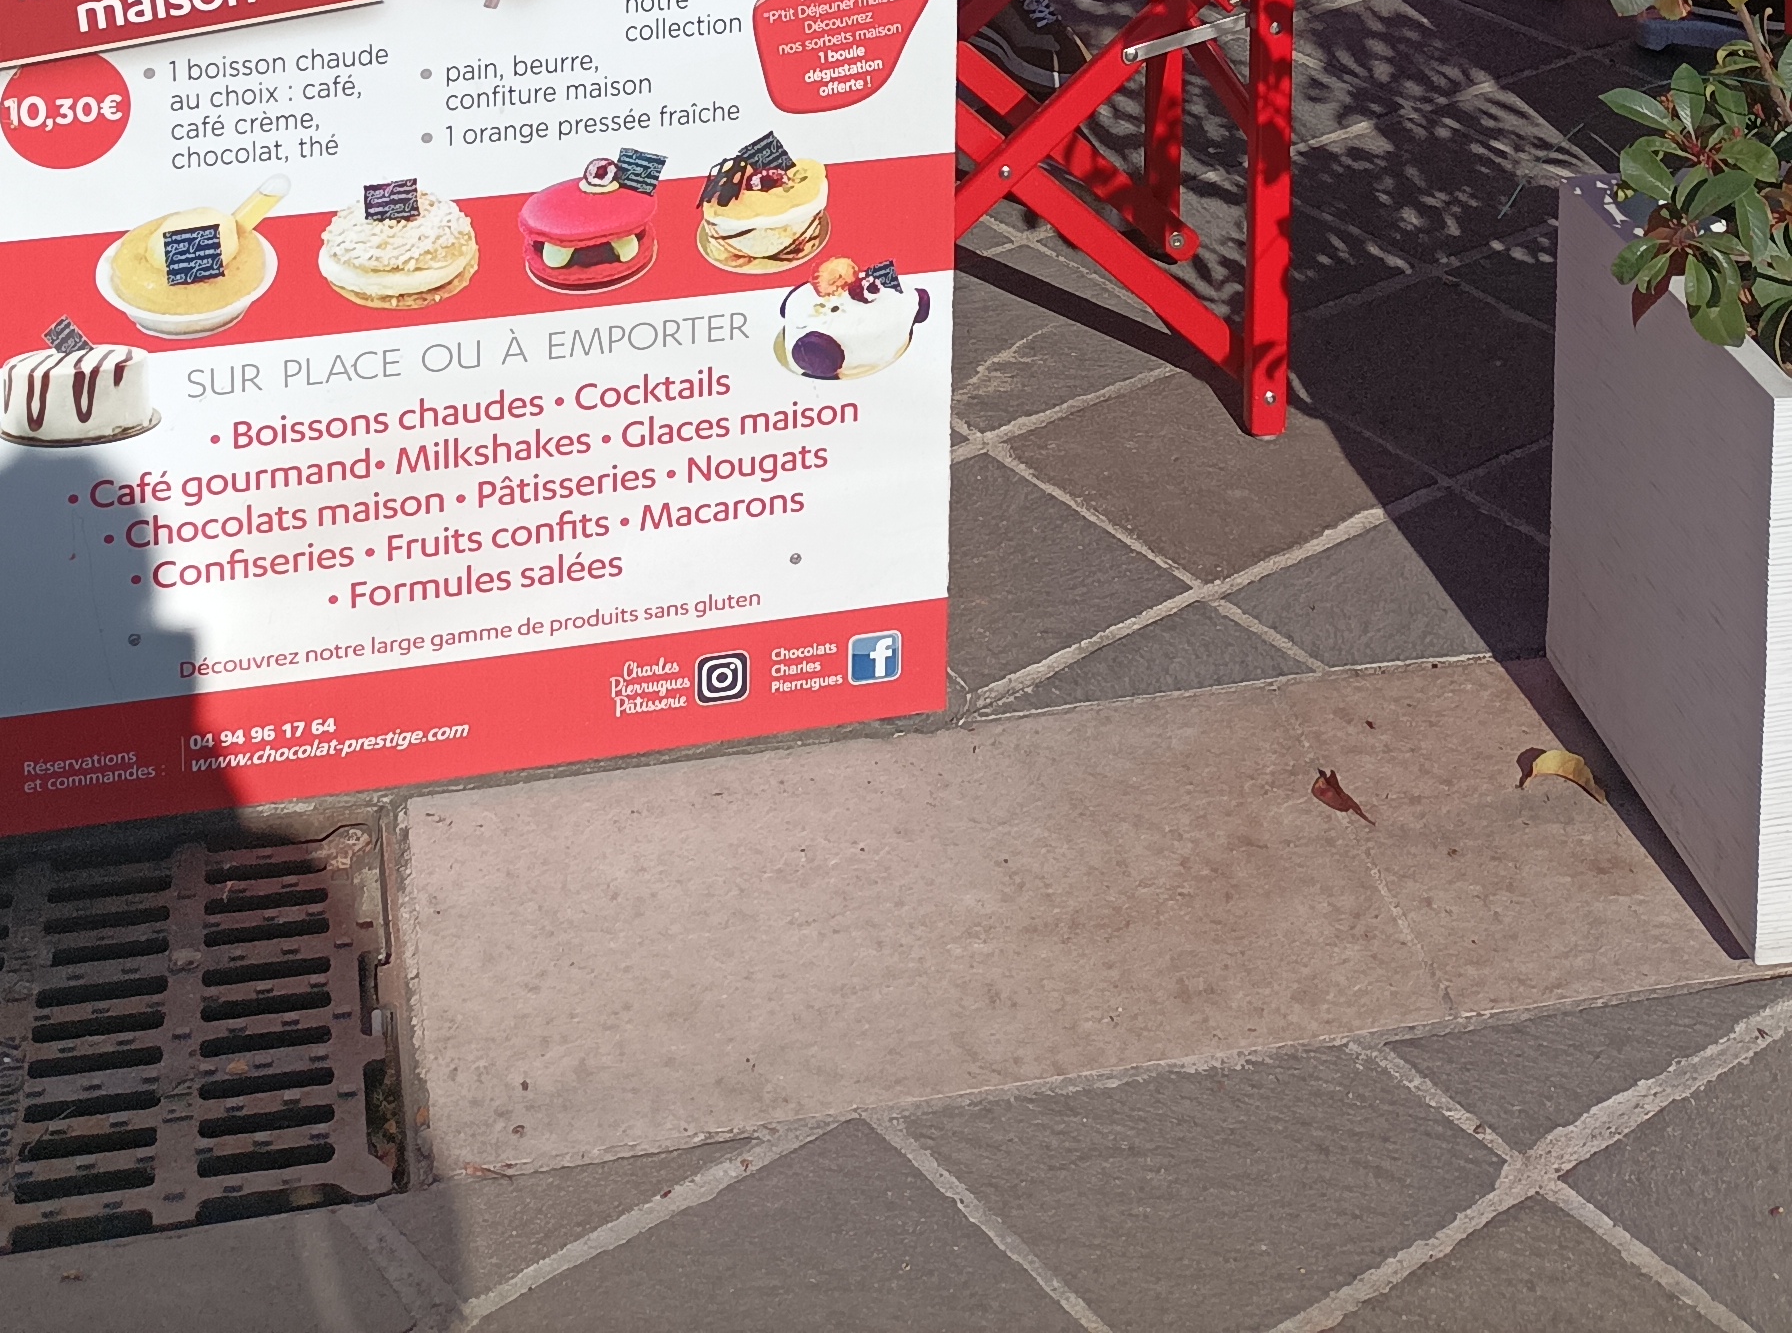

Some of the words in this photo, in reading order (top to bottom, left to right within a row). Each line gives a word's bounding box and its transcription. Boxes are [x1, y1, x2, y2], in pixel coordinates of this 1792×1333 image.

[624, 13, 743, 42] collection
[804, 11, 873, 34] Découvrez
[778, 41, 803, 55] nos
[805, 30, 853, 51] sorbets
[855, 23, 902, 40] maison
[827, 44, 866, 62] boule
[187, 52, 287, 81] boisson
[295, 44, 389, 72] chaude
[446, 58, 505, 87] pain,
[513, 54, 600, 77] beurre,
[804, 59, 883, 83] dégustation
[209, 82, 280, 108] choix
[302, 75, 362, 102] café,
[445, 85, 557, 111] confiture
[566, 76, 652, 101] maison
[819, 78, 864, 96] offerte
[4, 93, 123, 131] 10,30€
[170, 115, 225, 142] café
[234, 111, 320, 136] crème,
[462, 121, 549, 145] orange
[558, 108, 651, 141] pressée
[659, 101, 741, 128] fraîche
[171, 140, 289, 170] chocolat,
[298, 135, 339, 158] thé
[186, 363, 264, 400] SUR
[282, 348, 402, 388] PLACE
[421, 339, 482, 373] OU
[501, 329, 528, 366] À
[548, 311, 750, 361] EMPORTER
[232, 407, 389, 450] Boissons
[398, 389, 545, 432] chaudes
[574, 366, 732, 412] Cocktails
[89, 470, 172, 509] Café
[181, 448, 372, 507] gourmand
[395, 429, 592, 475] Milkshakes
[621, 415, 730, 449] Glaces
[740, 399, 859, 436] maison
[125, 504, 308, 550] Chocolats
[317, 490, 446, 528] maison
[477, 465, 656, 509] Pâtisseries
[686, 444, 829, 485] Nougats
[152, 543, 355, 590] Confiseries
[386, 520, 483, 562] Fruits
[490, 509, 610, 549] confits
[639, 491, 805, 532] Macarons
[349, 565, 512, 609] Formules
[520, 551, 624, 589] salées
[179, 651, 299, 679] Découvrez
[305, 639, 366, 663] notre
[371, 634, 425, 657] large
[430, 624, 513, 651] gamme
[517, 617, 544, 637] de
[550, 606, 639, 636] produits
[643, 602, 689, 619] sans
[693, 591, 761, 619] gluten
[771, 641, 837, 661] Chocolats
[623, 657, 680, 678] Charles
[771, 660, 821, 677] Charles
[771, 674, 843, 693] Pierrugues
[609, 676, 691, 699] Pierrugues
[614, 693, 688, 717] Pâtisserie
[189, 733, 215, 750] 04
[220, 729, 245, 745] 94
[250, 726, 276, 743] 96
[281, 722, 305, 739] 17
[311, 718, 337, 735] 64
[191, 723, 470, 772] www.chocolat-prestige.com
[24, 751, 137, 776] Réservations
[24, 780, 42, 793] et
[47, 764, 156, 790] commandes
